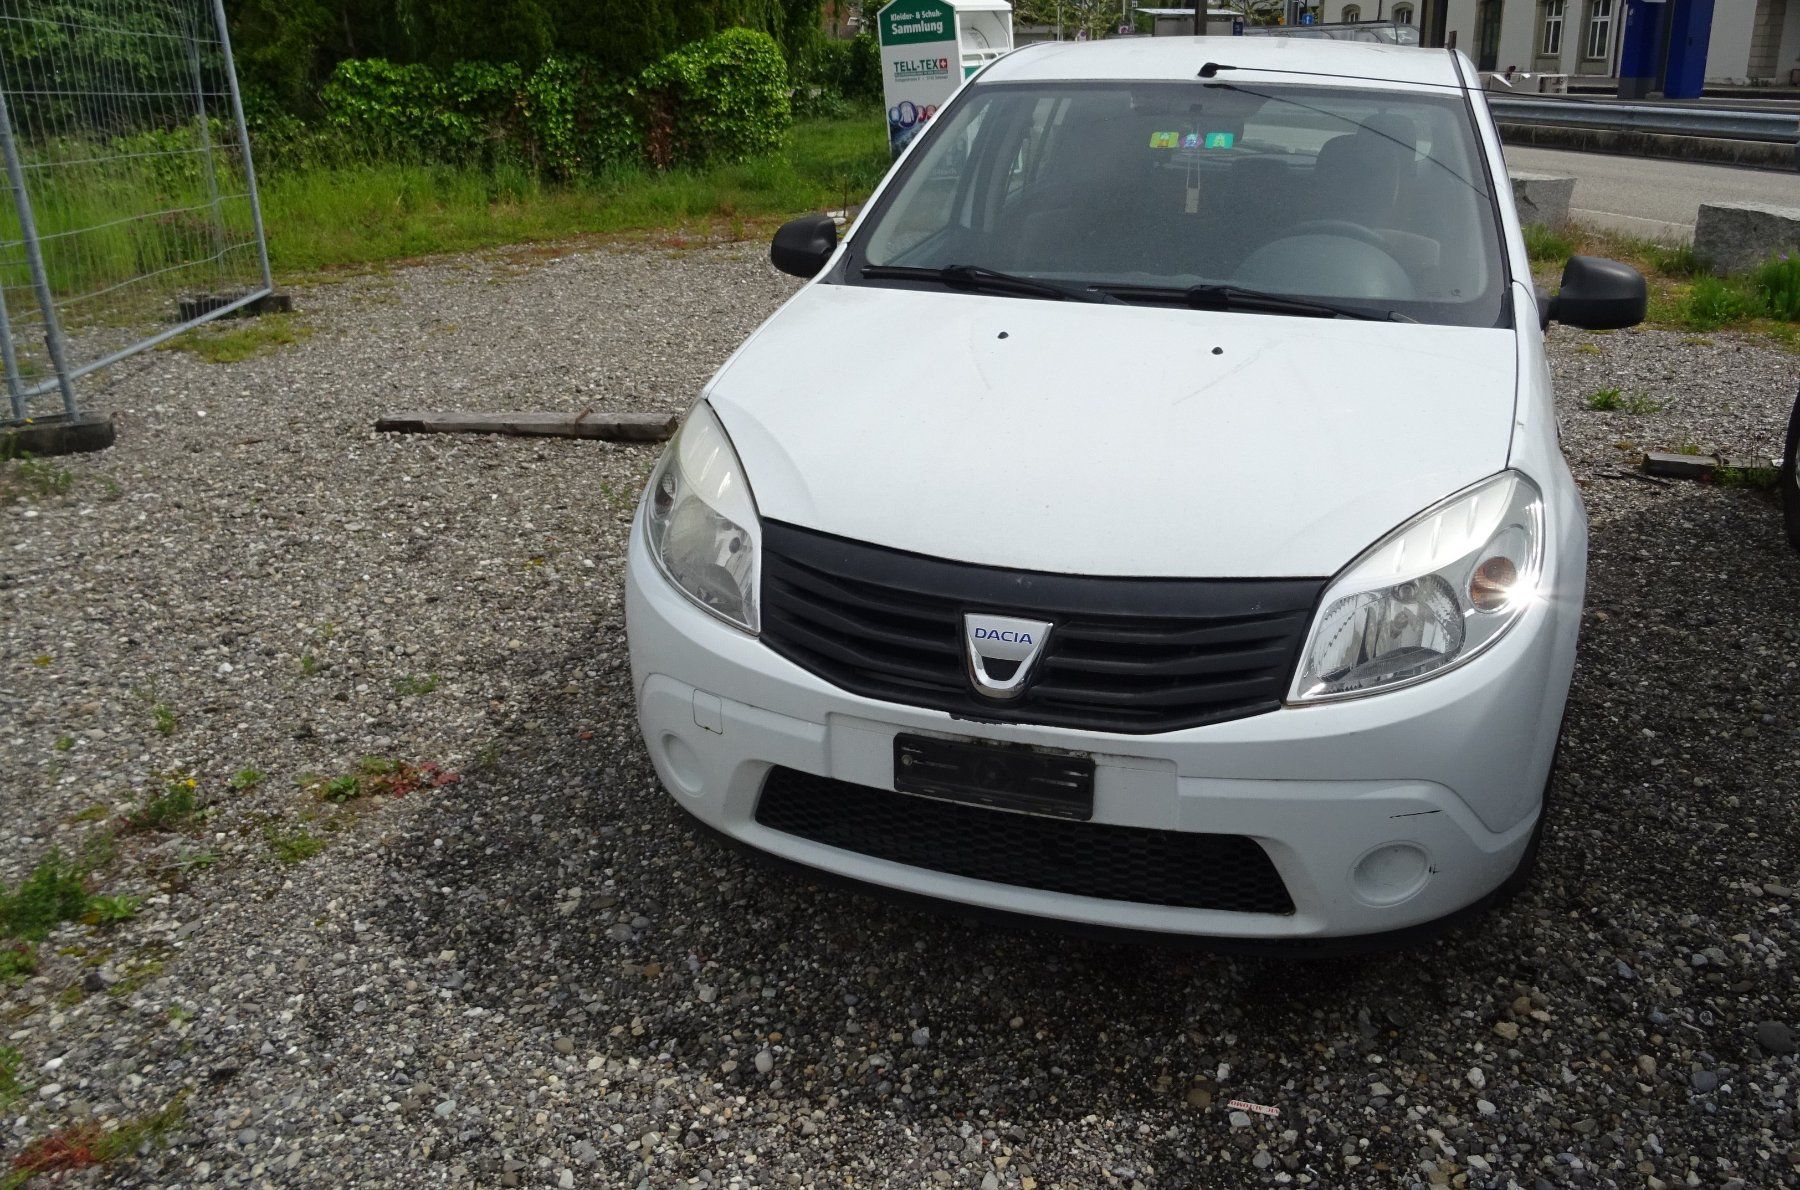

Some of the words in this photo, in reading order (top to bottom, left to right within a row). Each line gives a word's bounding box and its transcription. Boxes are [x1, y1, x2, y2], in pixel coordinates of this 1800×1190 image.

[890, 12, 914, 20] Kleider-
[915, 11, 921, 19] &
[921, 9, 942, 18] Schuh-
[891, 20, 943, 34] Sammlung
[893, 59, 939, 72] TELL-TEX
[974, 627, 1033, 645] DACIA
